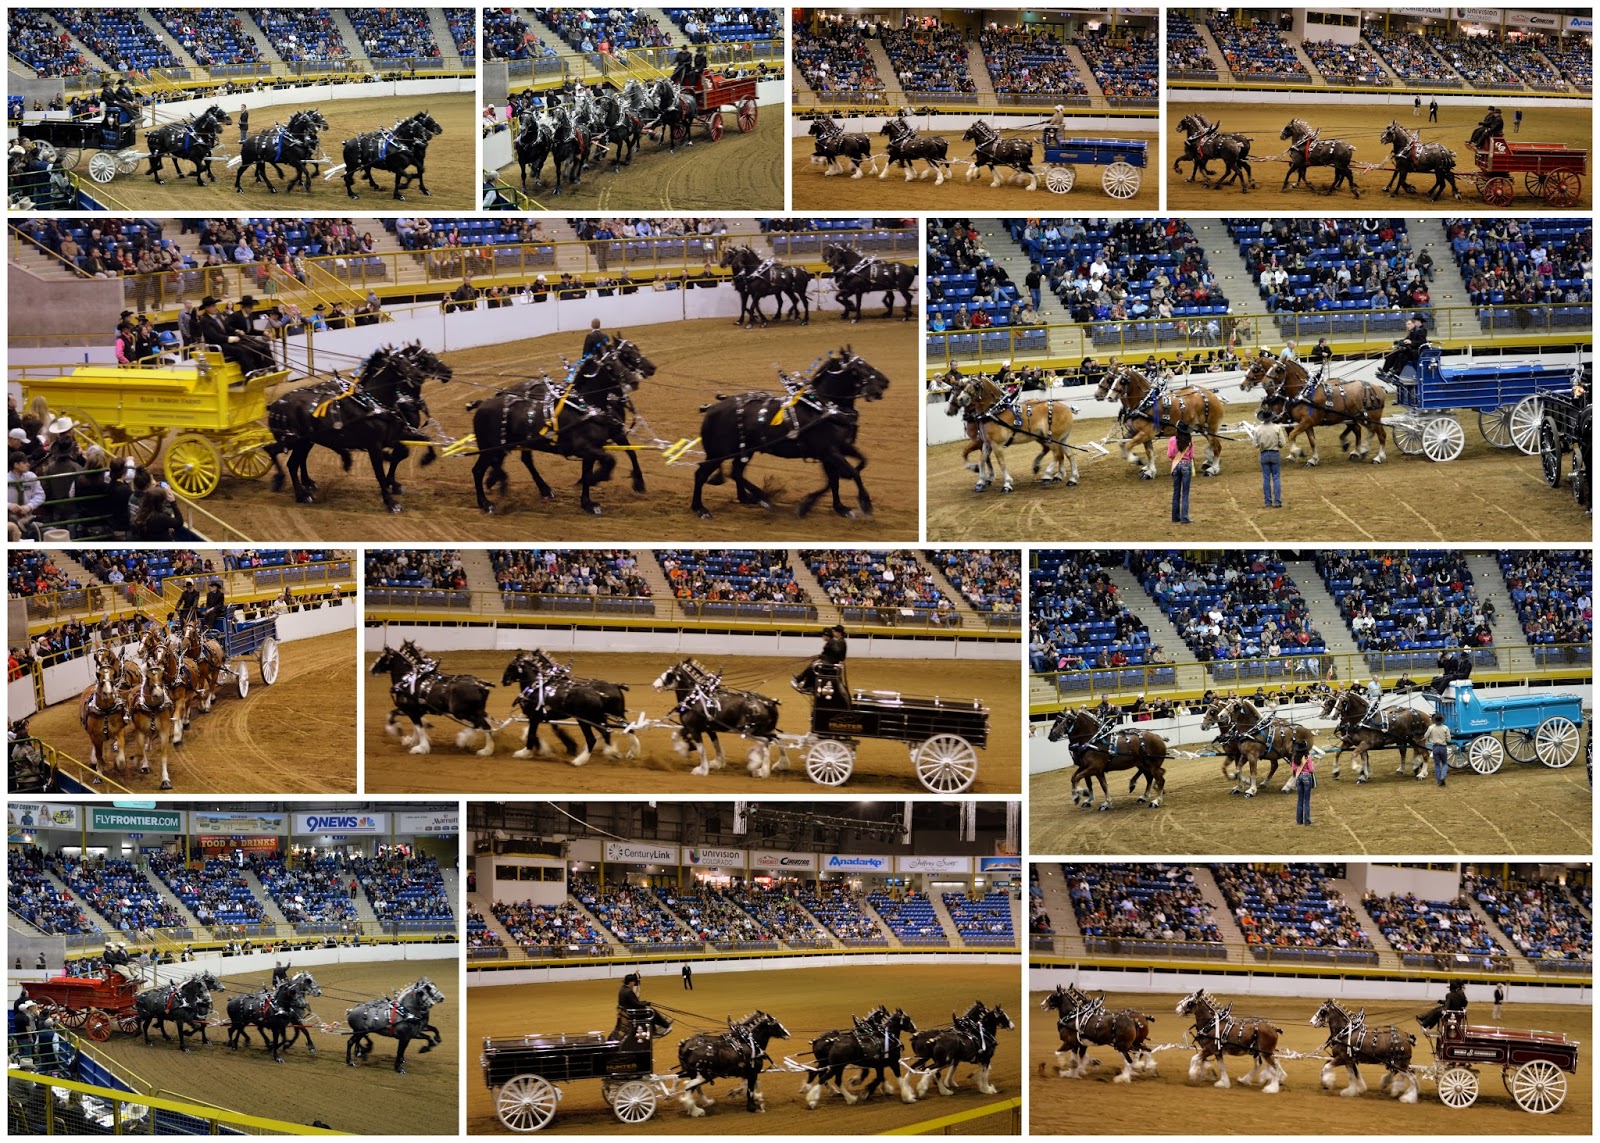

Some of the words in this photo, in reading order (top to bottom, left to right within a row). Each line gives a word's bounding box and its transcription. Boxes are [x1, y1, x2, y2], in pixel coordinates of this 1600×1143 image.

[95, 814, 178, 827] FLYFRONTIER.COM
[306, 816, 358, 832] 9NEWS
[201, 840, 226, 848] FOOD
[241, 838, 275, 847] DRINKS
[624, 848, 671, 860] CenturyLink
[702, 858, 733, 866] COLORADO
[829, 856, 882, 867] Anadarko
